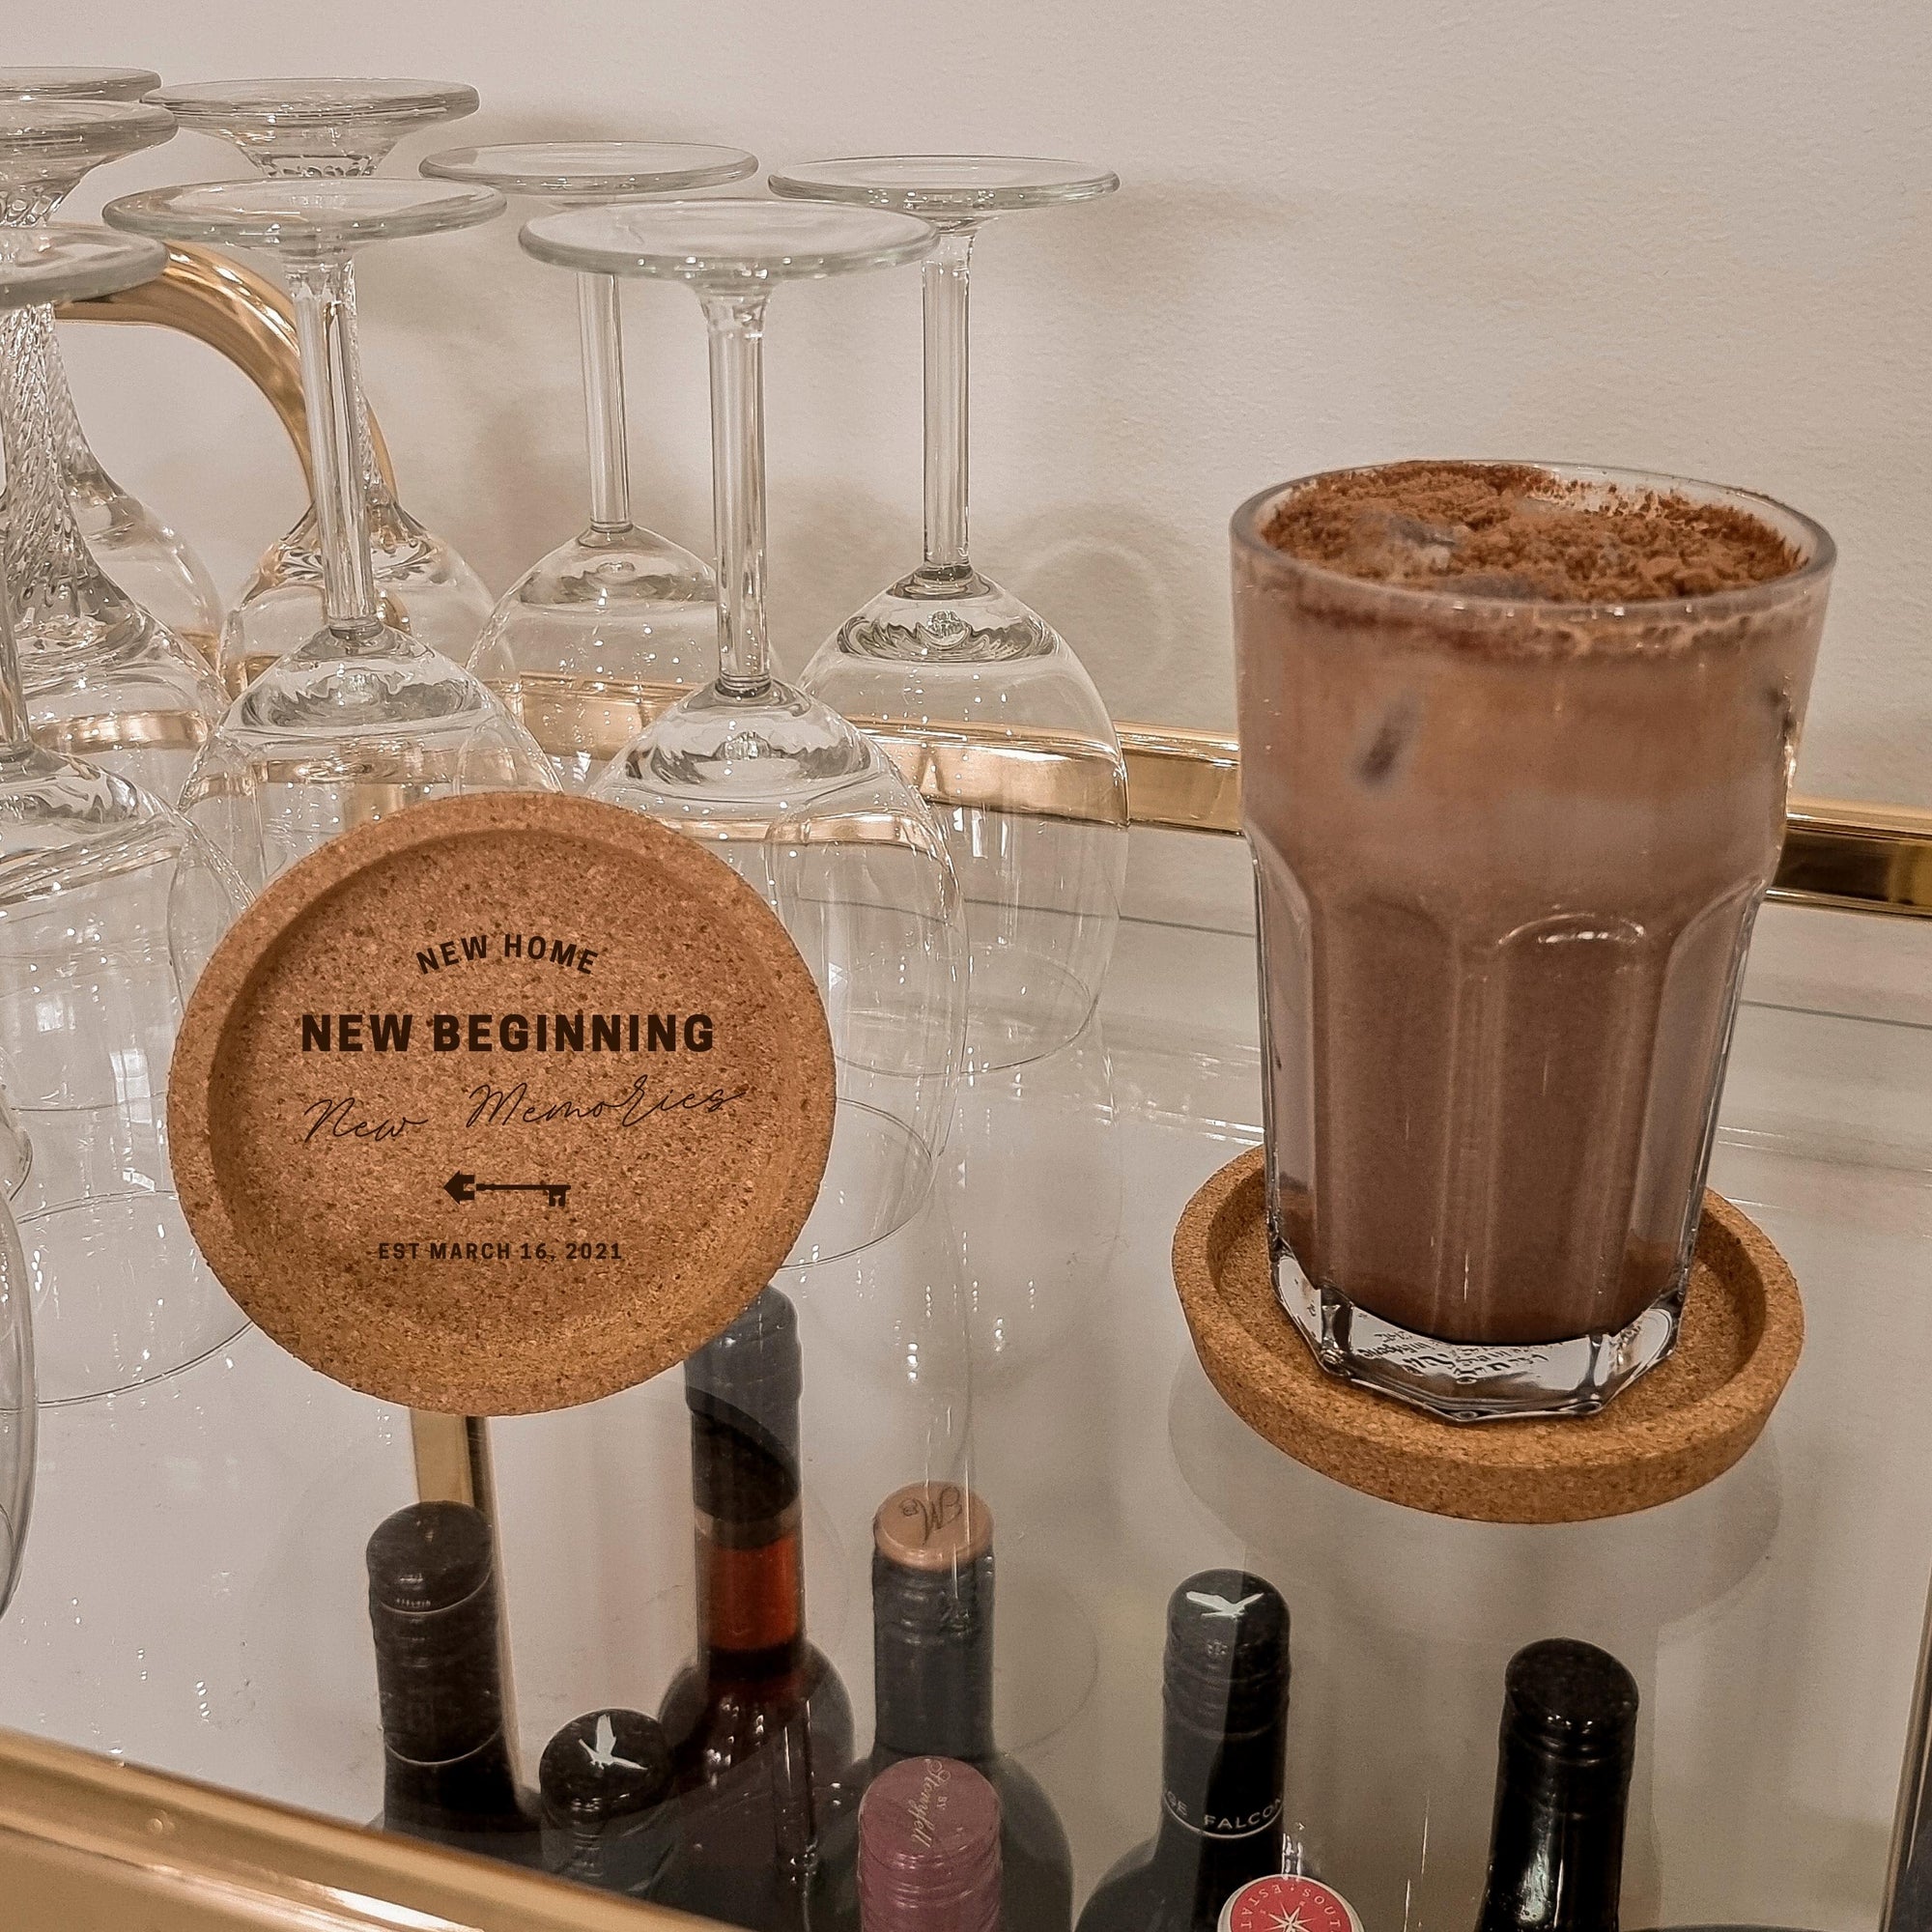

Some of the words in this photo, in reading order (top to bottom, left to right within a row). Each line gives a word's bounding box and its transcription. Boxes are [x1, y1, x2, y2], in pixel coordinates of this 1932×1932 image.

[415, 934, 488, 975] NEW
[504, 933, 599, 975] HOME
[301, 1013, 413, 1052] NEW
[433, 1012, 714, 1053] BEGINNING
[303, 1096, 429, 1144] New
[466, 1074, 748, 1128] Memories
[378, 1242, 420, 1260] EST
[430, 1242, 510, 1260] MARCH
[565, 1242, 622, 1260] 2021
[1301, 1887, 1341, 1932] SOUT
